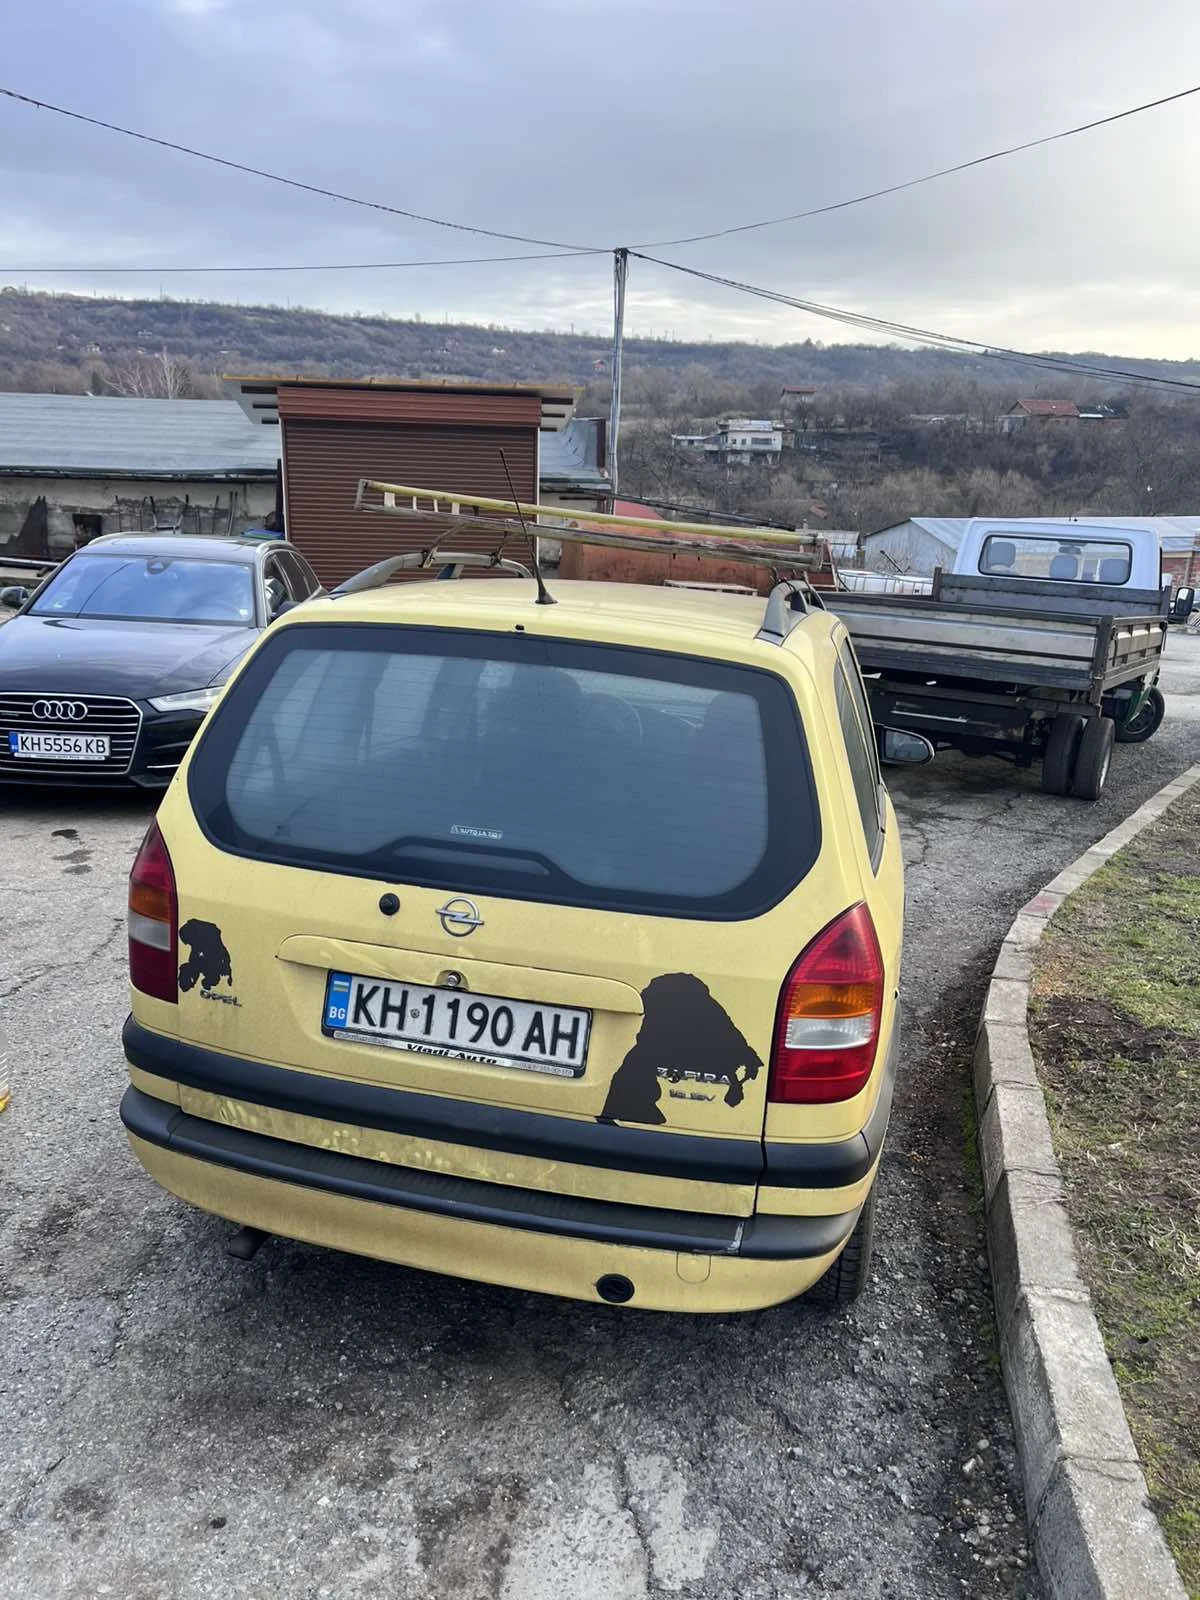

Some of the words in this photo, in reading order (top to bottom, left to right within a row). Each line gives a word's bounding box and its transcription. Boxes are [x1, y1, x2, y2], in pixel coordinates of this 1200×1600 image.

[44, 737, 82, 753] 5556
[329, 1006, 346, 1020] BG
[352, 983, 409, 1031] KH
[422, 993, 514, 1048] 1190
[521, 1011, 580, 1060] AH
[406, 1043, 497, 1064] Vladi-Auto
